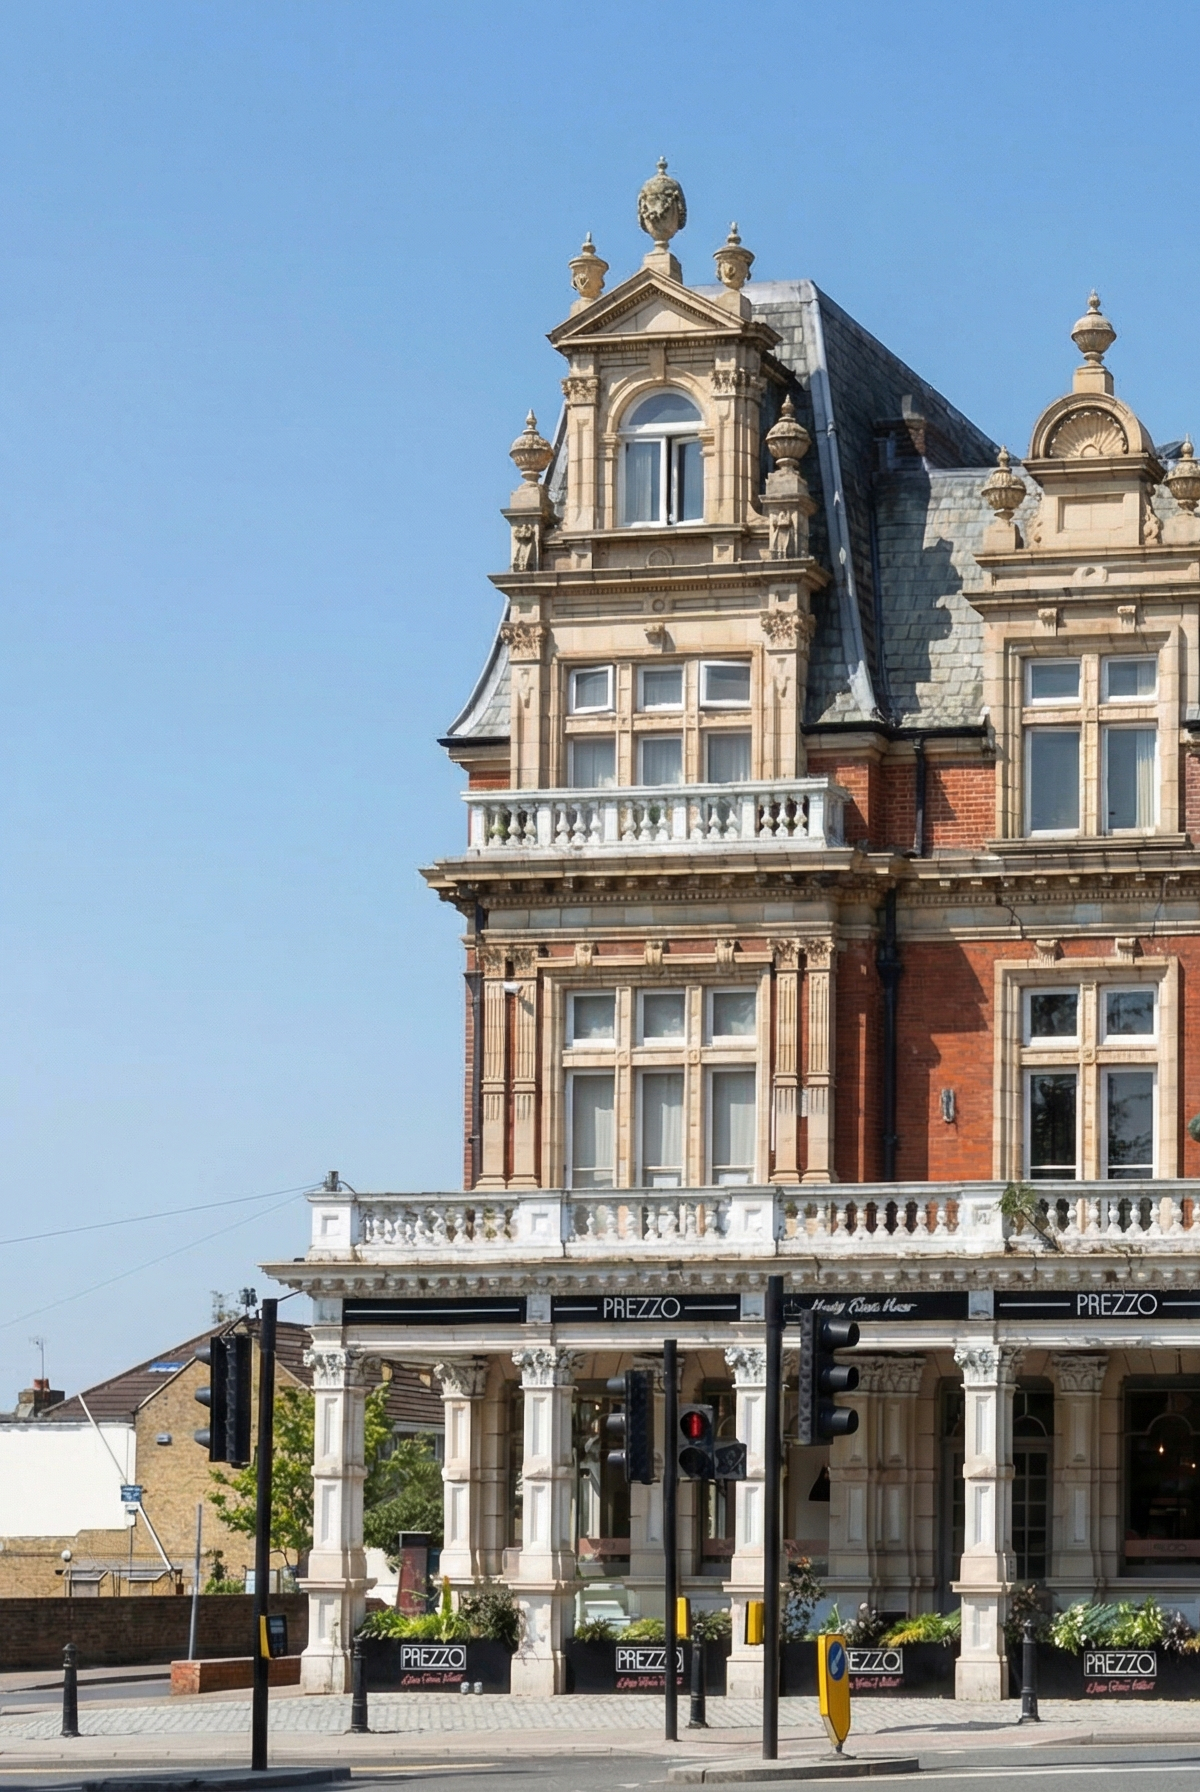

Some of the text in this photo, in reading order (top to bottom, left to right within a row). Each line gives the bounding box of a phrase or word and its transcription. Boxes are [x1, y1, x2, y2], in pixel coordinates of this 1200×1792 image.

[603, 1297, 680, 1318] PREZZO
[1077, 1293, 1158, 1315] PREZZO
[403, 1647, 464, 1667] PREZZO
[846, 1651, 900, 1671] EZZO
[1086, 1654, 1155, 1674] PREZZO
